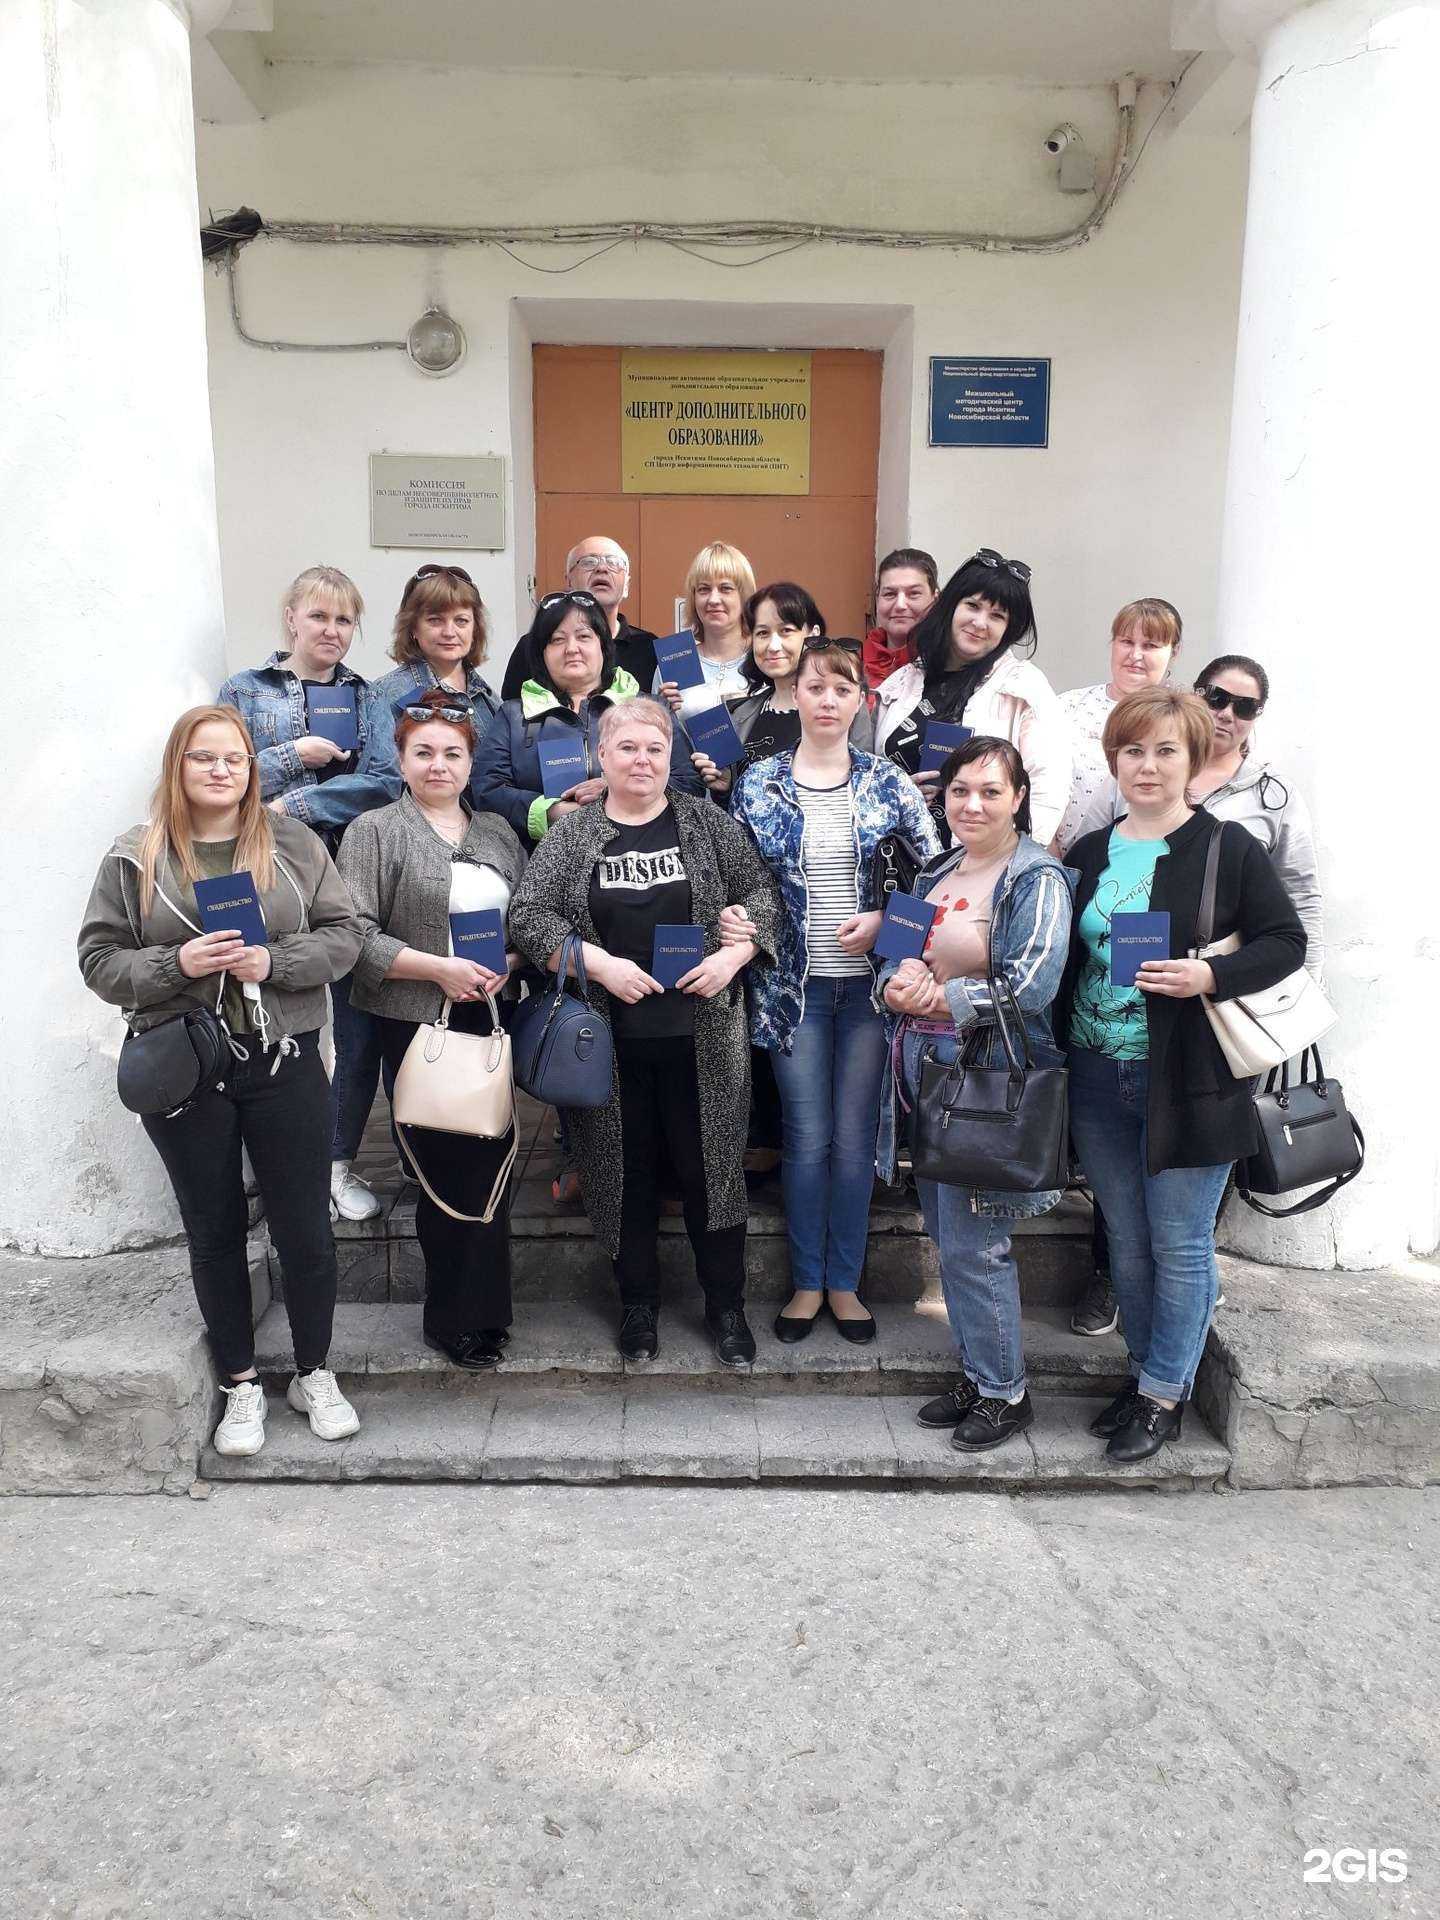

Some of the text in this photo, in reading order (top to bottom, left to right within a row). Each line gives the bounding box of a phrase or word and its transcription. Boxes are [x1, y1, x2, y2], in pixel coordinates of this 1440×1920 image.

[627, 374, 679, 383] Муниципальное
[717, 375, 768, 383] образовательное
[724, 383, 764, 391] образования
[965, 389, 1014, 397] Межшкольный
[955, 398, 1002, 406] методический
[625, 401, 807, 421] «ЦЕНТР ДОПОЛНИТЕЛЬНОГО
[948, 413, 1001, 421] Новосибирской
[668, 427, 764, 446] ОБРАЗОВАНИЯ»
[707, 455, 754, 463] Новосибирской
[677, 462, 733, 470] информационных
[409, 480, 466, 489] КОМИССИЯ
[545, 756, 582, 766] СВИДЕТЕЛЬСТВО
[206, 896, 253, 912] СВИДЕТЕЛЬСТВО
[457, 931, 498, 942] СВИДЕТЕЛЬСТВО
[1117, 936, 1163, 945] СВИДЕТЕЛЬСТВО
